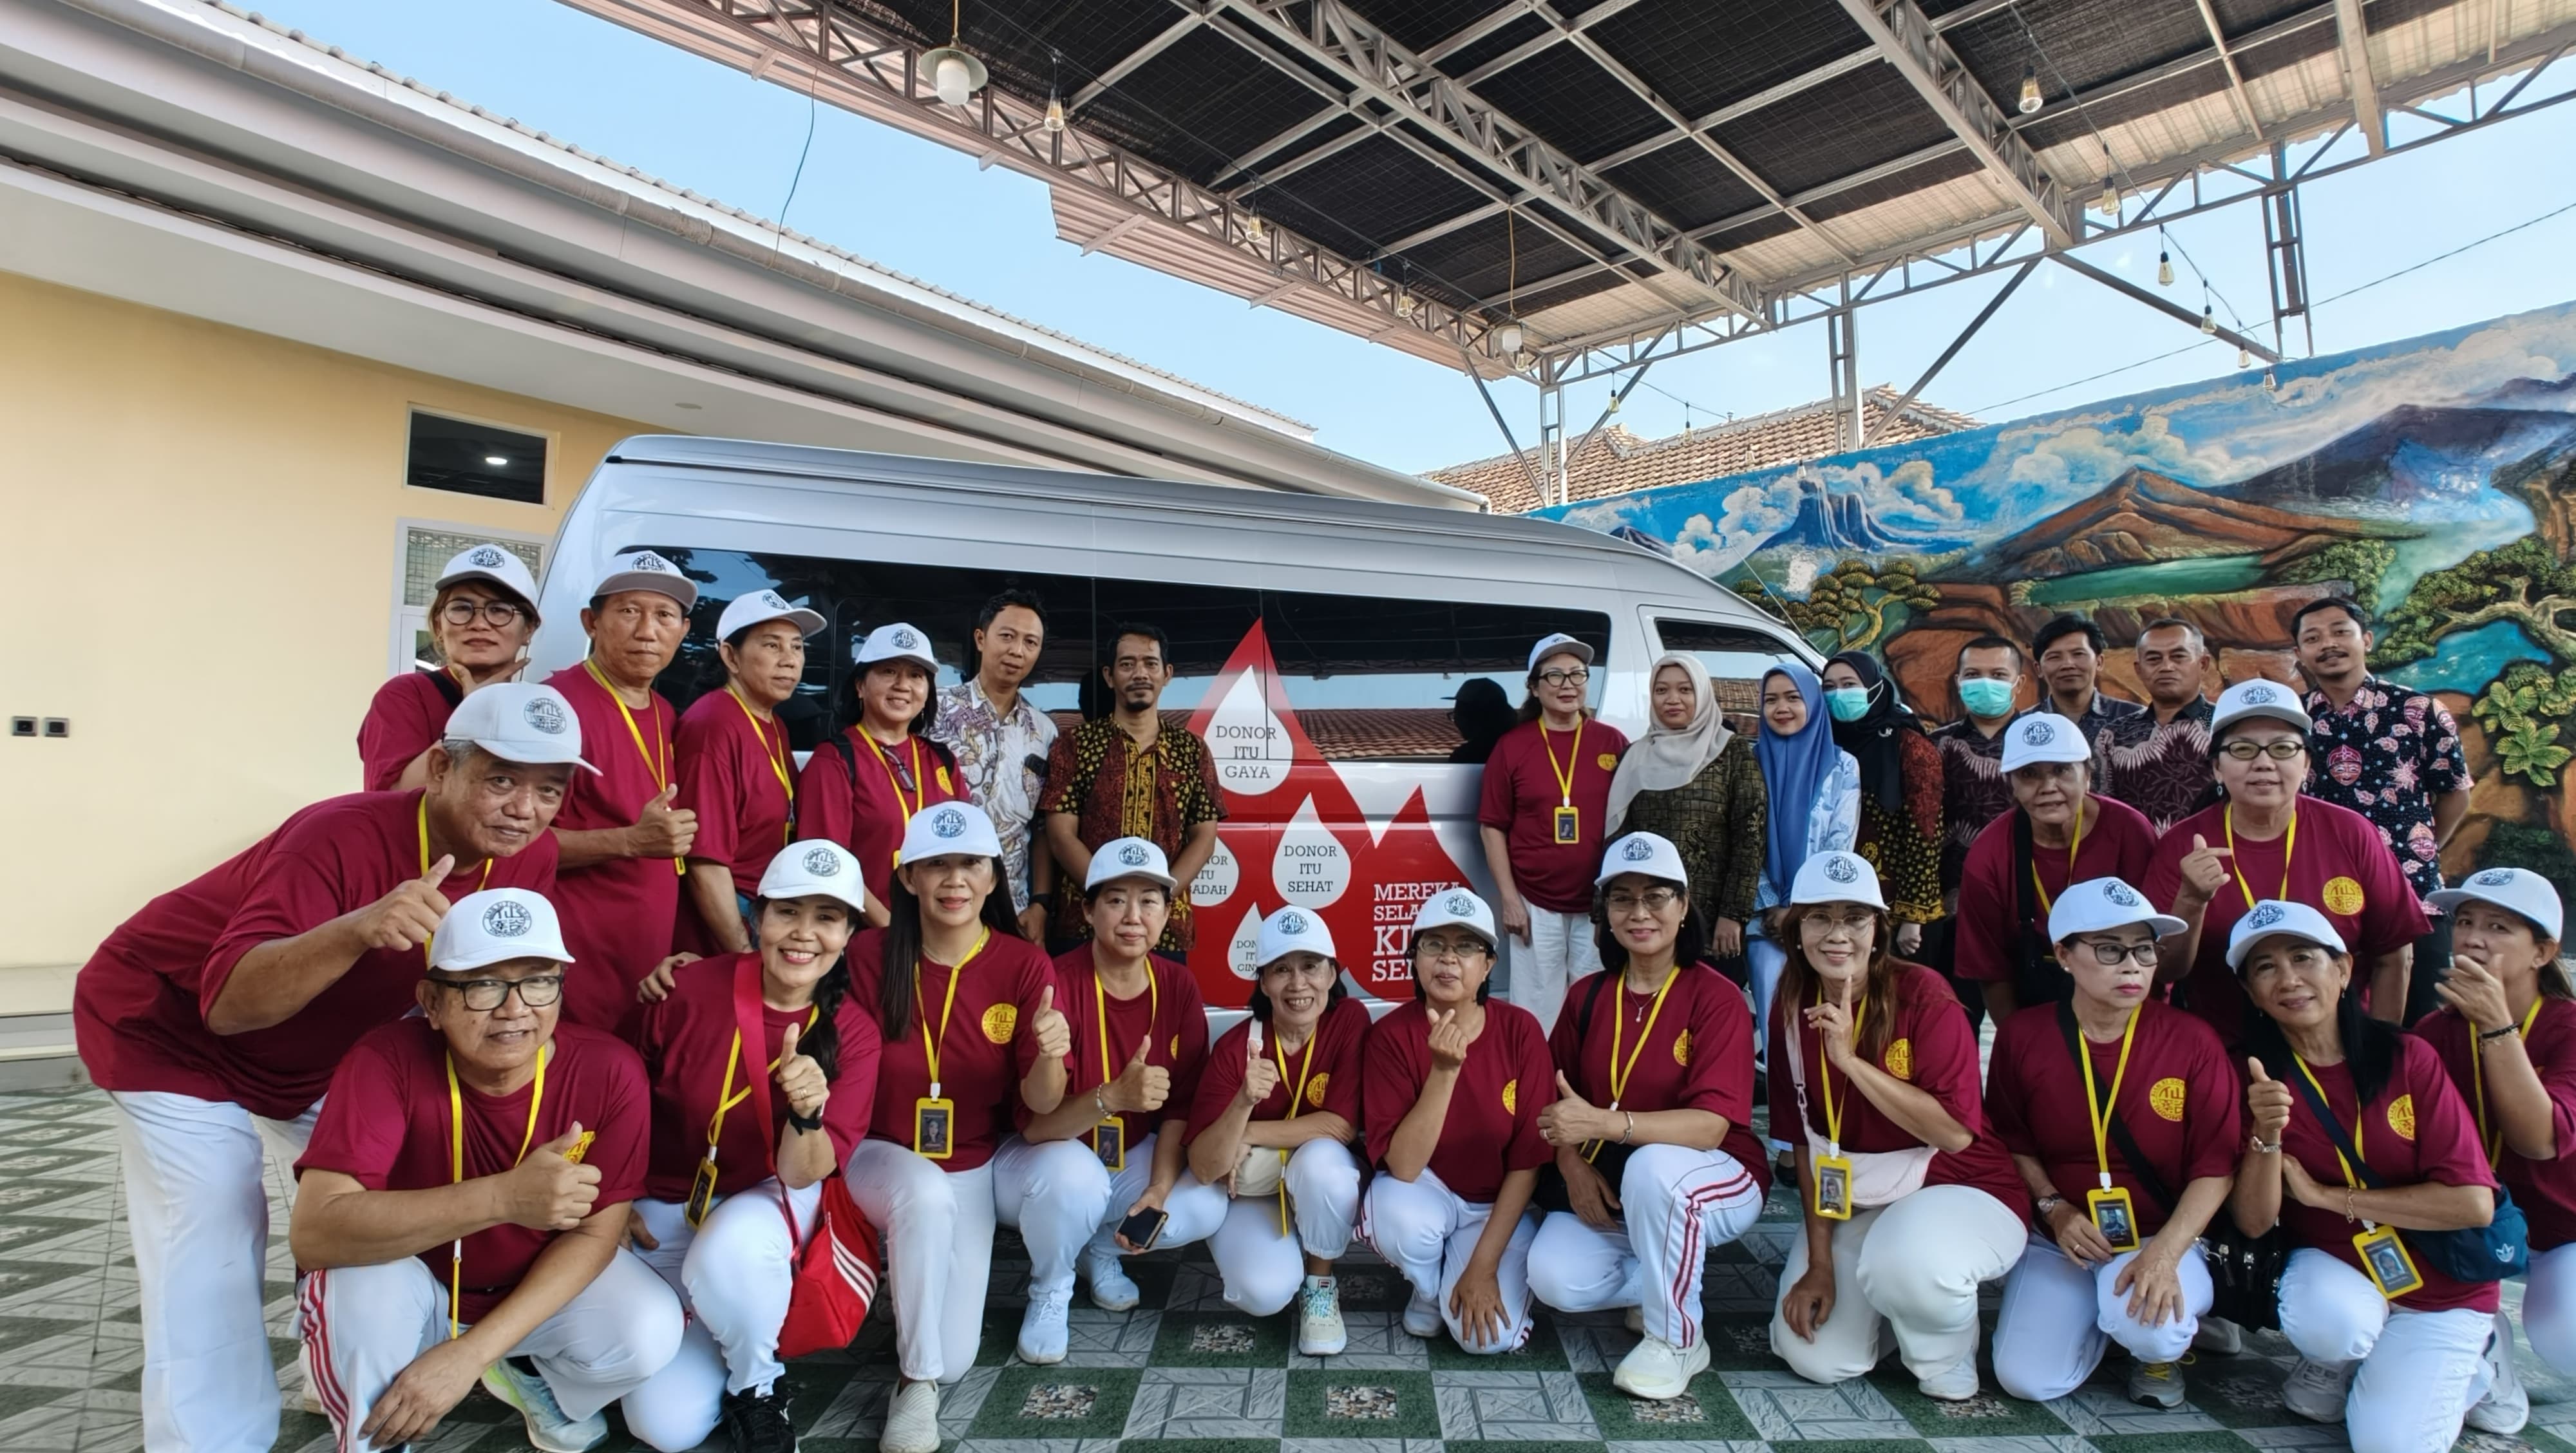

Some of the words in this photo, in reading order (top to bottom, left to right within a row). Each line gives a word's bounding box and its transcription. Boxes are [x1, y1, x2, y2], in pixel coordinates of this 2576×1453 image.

[1216, 725, 1277, 739] DONOR
[1234, 746, 1259, 759] ITU
[1225, 765, 1271, 778] GAYA
[1284, 845, 1338, 857] DONOR
[1206, 855, 1228, 865] OR
[1300, 863, 1321, 875] ITU
[1189, 885, 1227, 895] ADAH
[1288, 880, 1334, 893] SEHAT
[1374, 904, 1425, 922] SELA
[1373, 925, 1415, 956] KI
